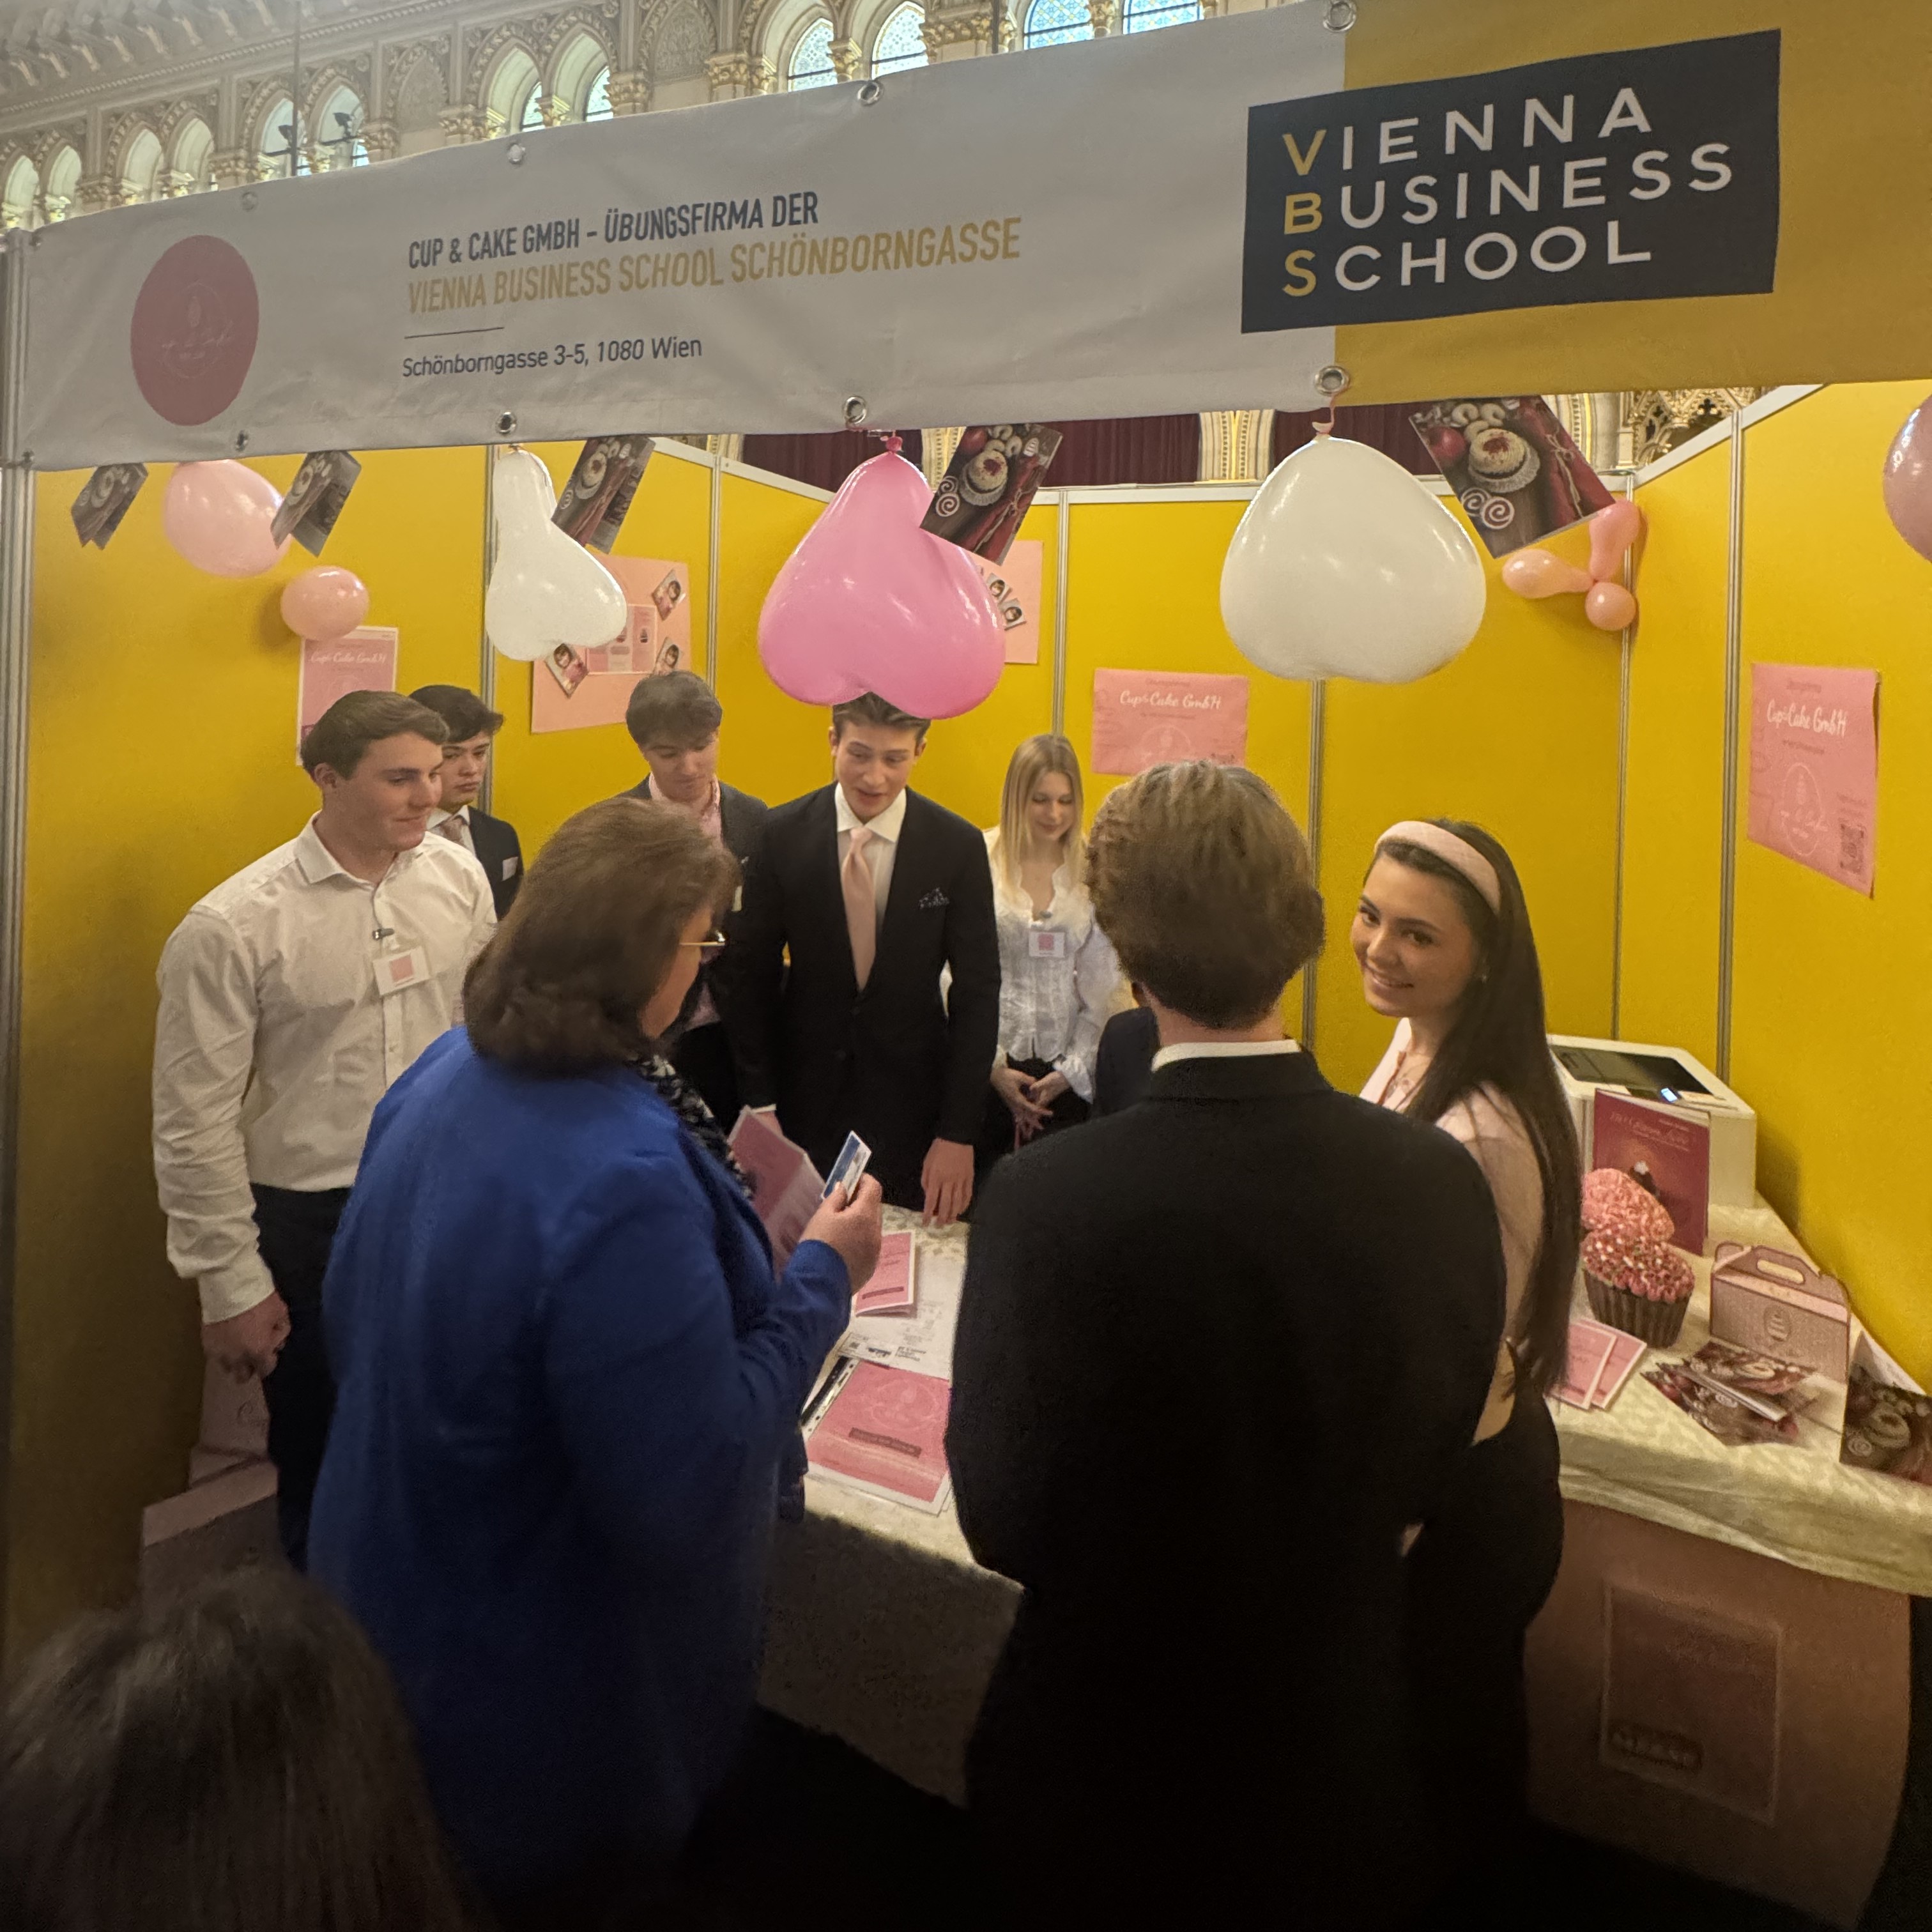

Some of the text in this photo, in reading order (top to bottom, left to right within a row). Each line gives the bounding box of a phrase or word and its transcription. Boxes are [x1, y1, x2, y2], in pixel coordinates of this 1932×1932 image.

[1283, 88, 1652, 176] VIENNA
[1284, 142, 1732, 234] BUSINESS
[408, 238, 443, 269] CUP
[449, 238, 462, 264] &
[468, 227, 518, 261] CAKE
[523, 218, 579, 253] GMBH
[604, 197, 763, 243] ÜBUNGSFIRMA
[771, 191, 818, 227] DER
[408, 217, 1022, 314] VIENNA BUSINESS SCHOOL SCHÖNBORNGASSE
[1282, 220, 1652, 296] SCHOOL
[402, 335, 702, 378] Schönborngasse 3-5, 1080 Wien
